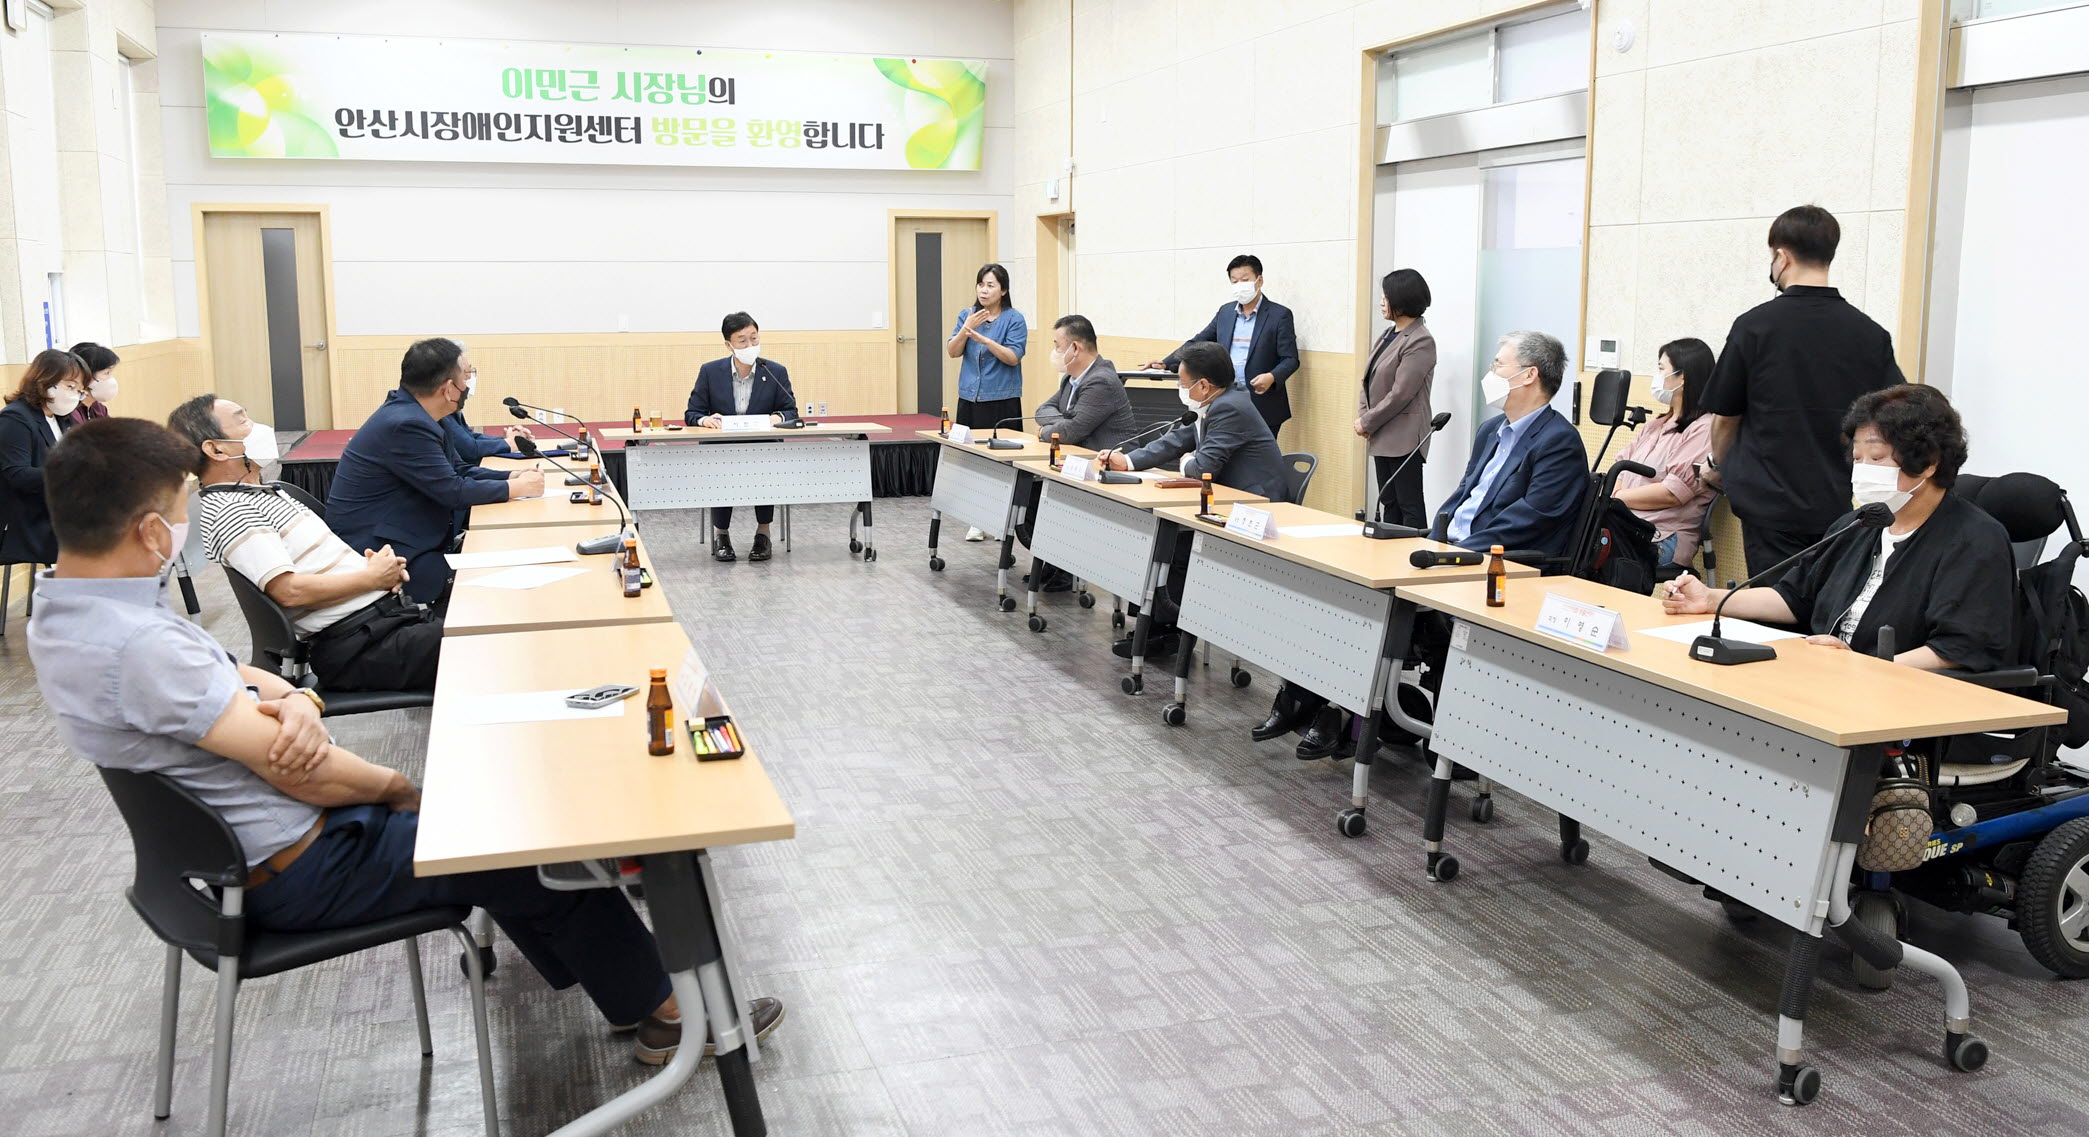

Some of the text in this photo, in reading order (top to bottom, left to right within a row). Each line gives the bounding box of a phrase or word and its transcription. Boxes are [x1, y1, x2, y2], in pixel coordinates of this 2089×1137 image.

[502, 67, 735, 105] 이민근 시장님의
[334, 107, 885, 150] 안산시장애인지원센터 방문을 환영합니다
